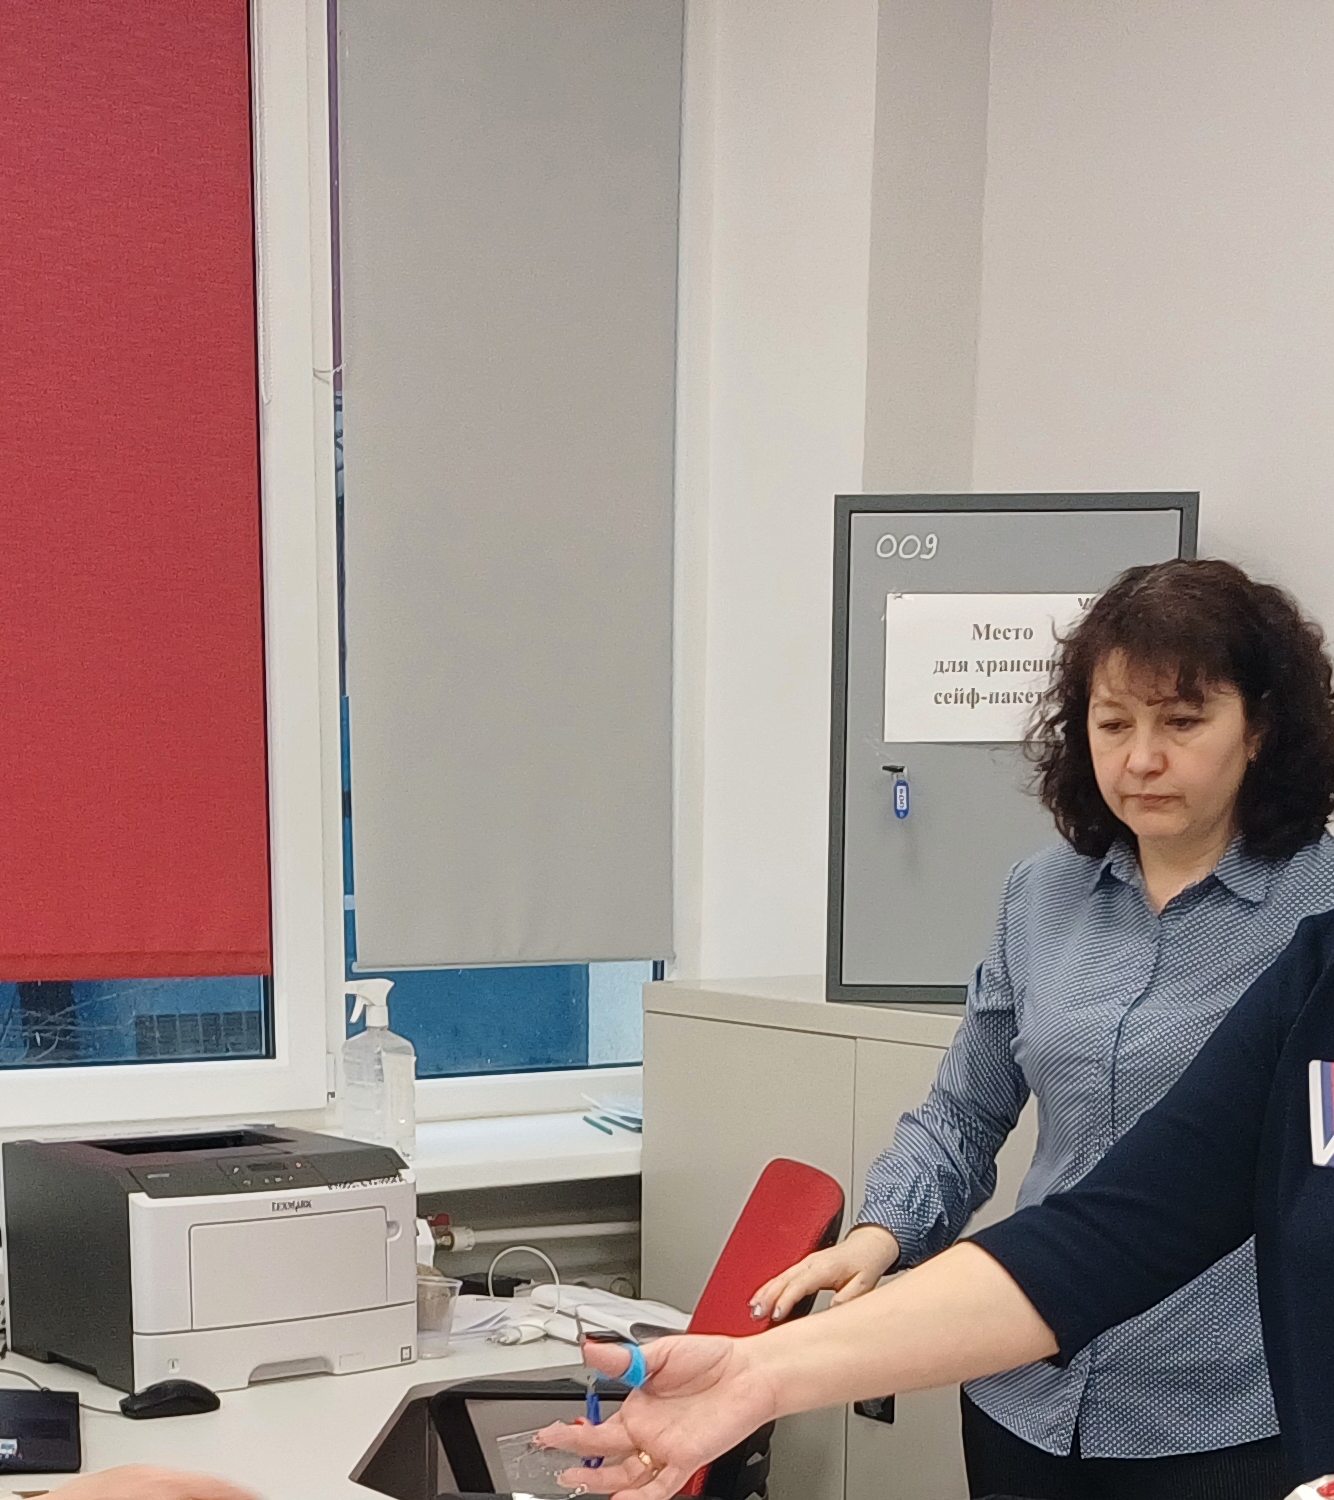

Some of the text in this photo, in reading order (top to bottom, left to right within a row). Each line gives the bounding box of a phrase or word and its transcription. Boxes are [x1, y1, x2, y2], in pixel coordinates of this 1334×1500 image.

[876, 533, 938, 559] 009
[971, 623, 1034, 641] Место
[933, 659, 969, 675] для
